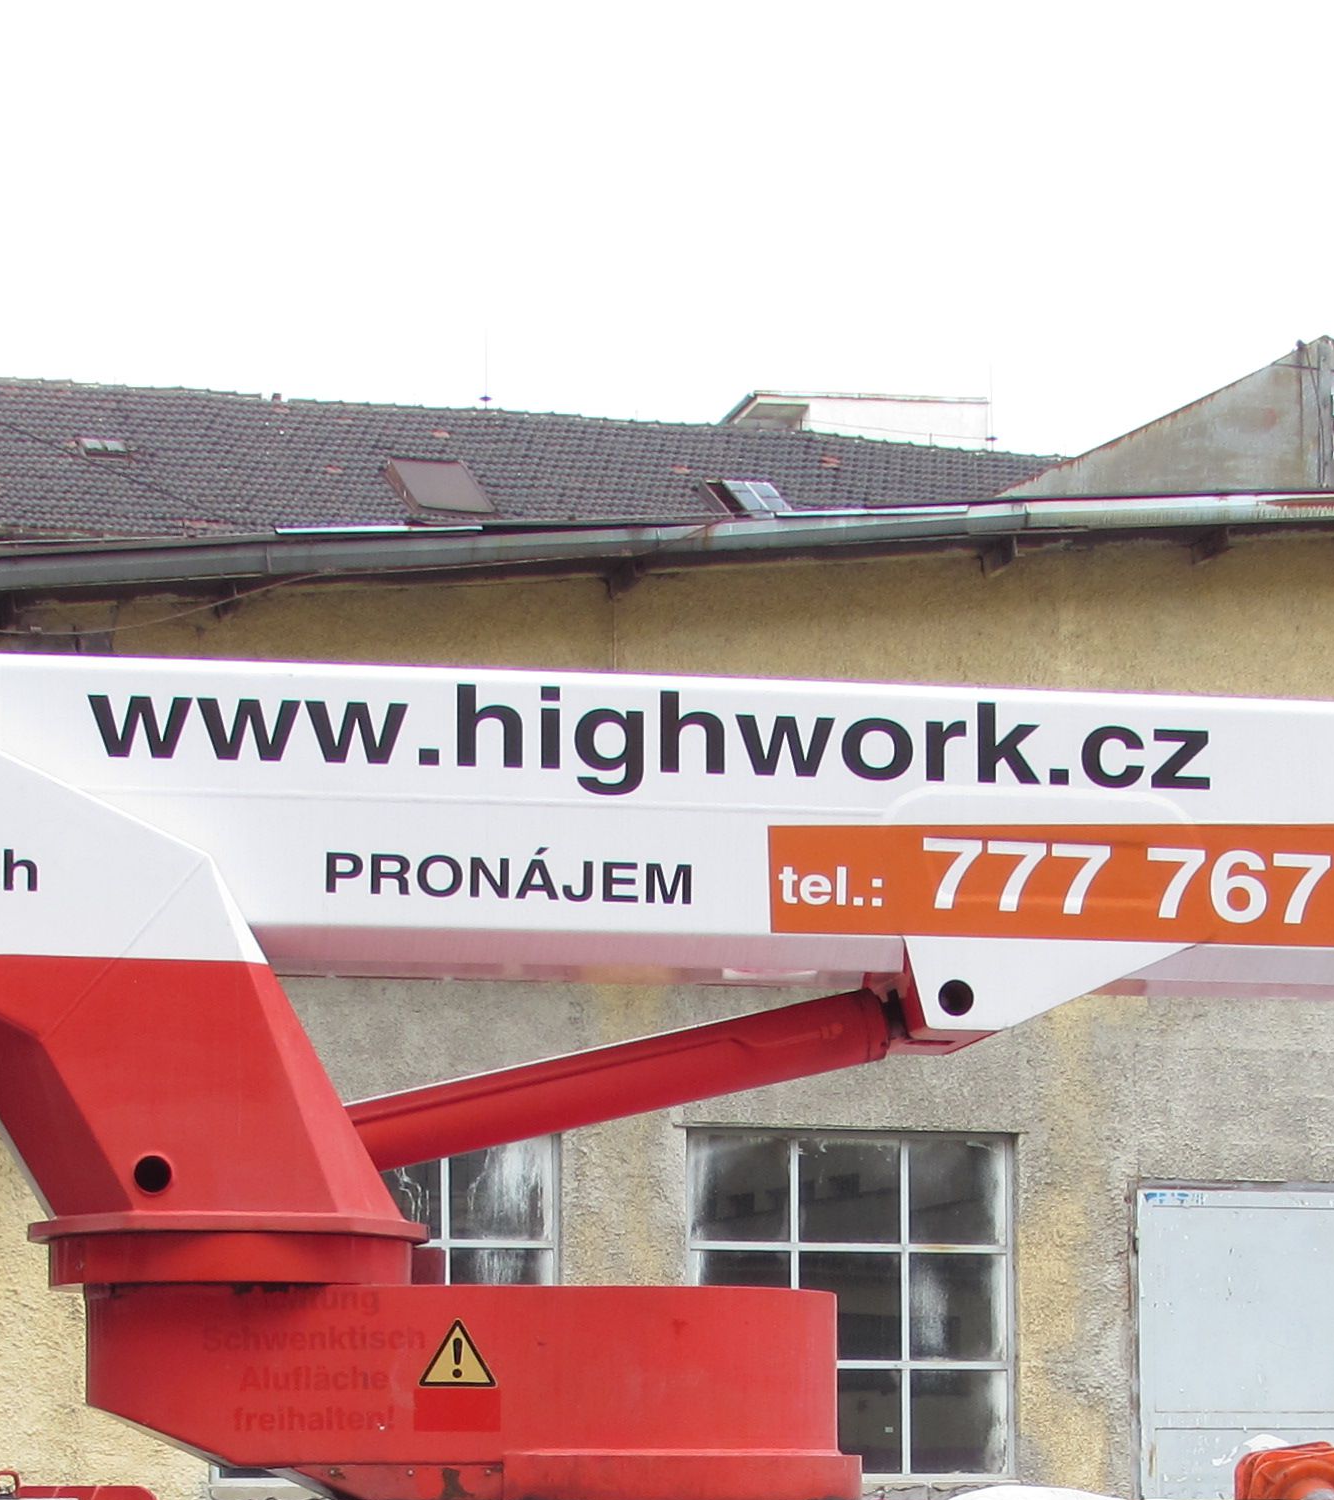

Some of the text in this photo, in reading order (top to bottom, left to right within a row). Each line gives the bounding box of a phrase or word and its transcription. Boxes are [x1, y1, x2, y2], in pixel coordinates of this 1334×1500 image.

[88, 684, 1210, 796] www.highwork.cz
[325, 846, 693, 904] PRONÁJEM
[778, 865, 884, 908] tel.:
[922, 836, 1111, 915] 777
[1146, 847, 1332, 926] 767
[239, 1364, 390, 1392] Alufläche
[233, 1405, 395, 1432] freihalten!
